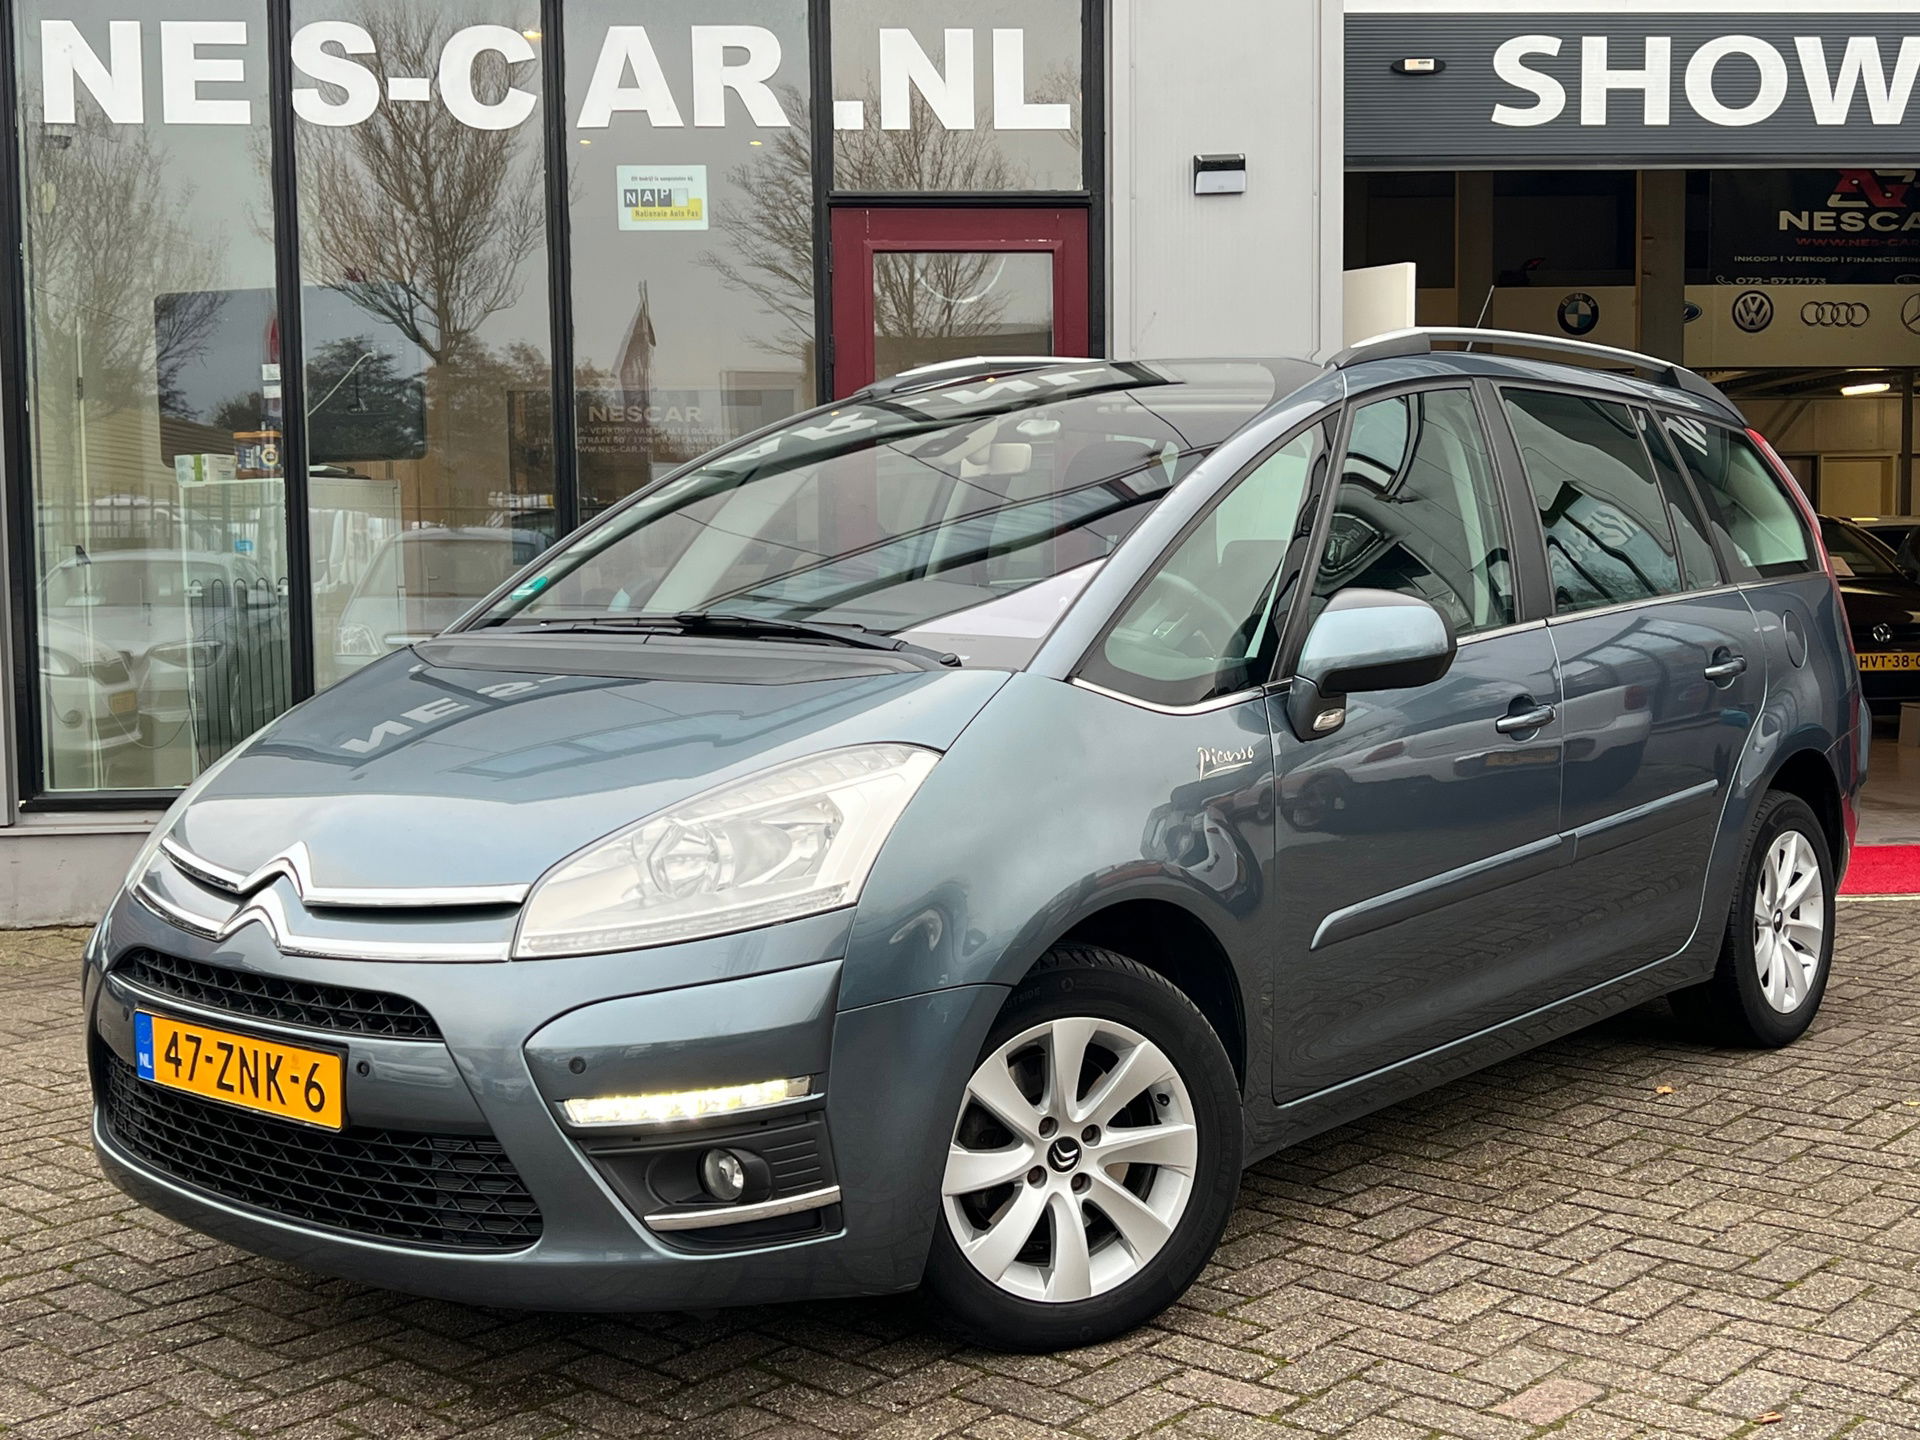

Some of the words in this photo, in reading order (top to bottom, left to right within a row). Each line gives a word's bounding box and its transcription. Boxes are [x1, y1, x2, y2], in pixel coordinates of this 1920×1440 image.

[1490, 34, 1920, 128] SHOW
[625, 188, 669, 205] NAP
[1734, 255, 1778, 263] INKOOP
[1786, 255, 1838, 263] VERKOOP
[588, 406, 704, 423] NESCAR
[1197, 744, 1255, 783] Picasso
[139, 1051, 152, 1068] NL
[164, 1031, 326, 1113] 47-ZNK-6
